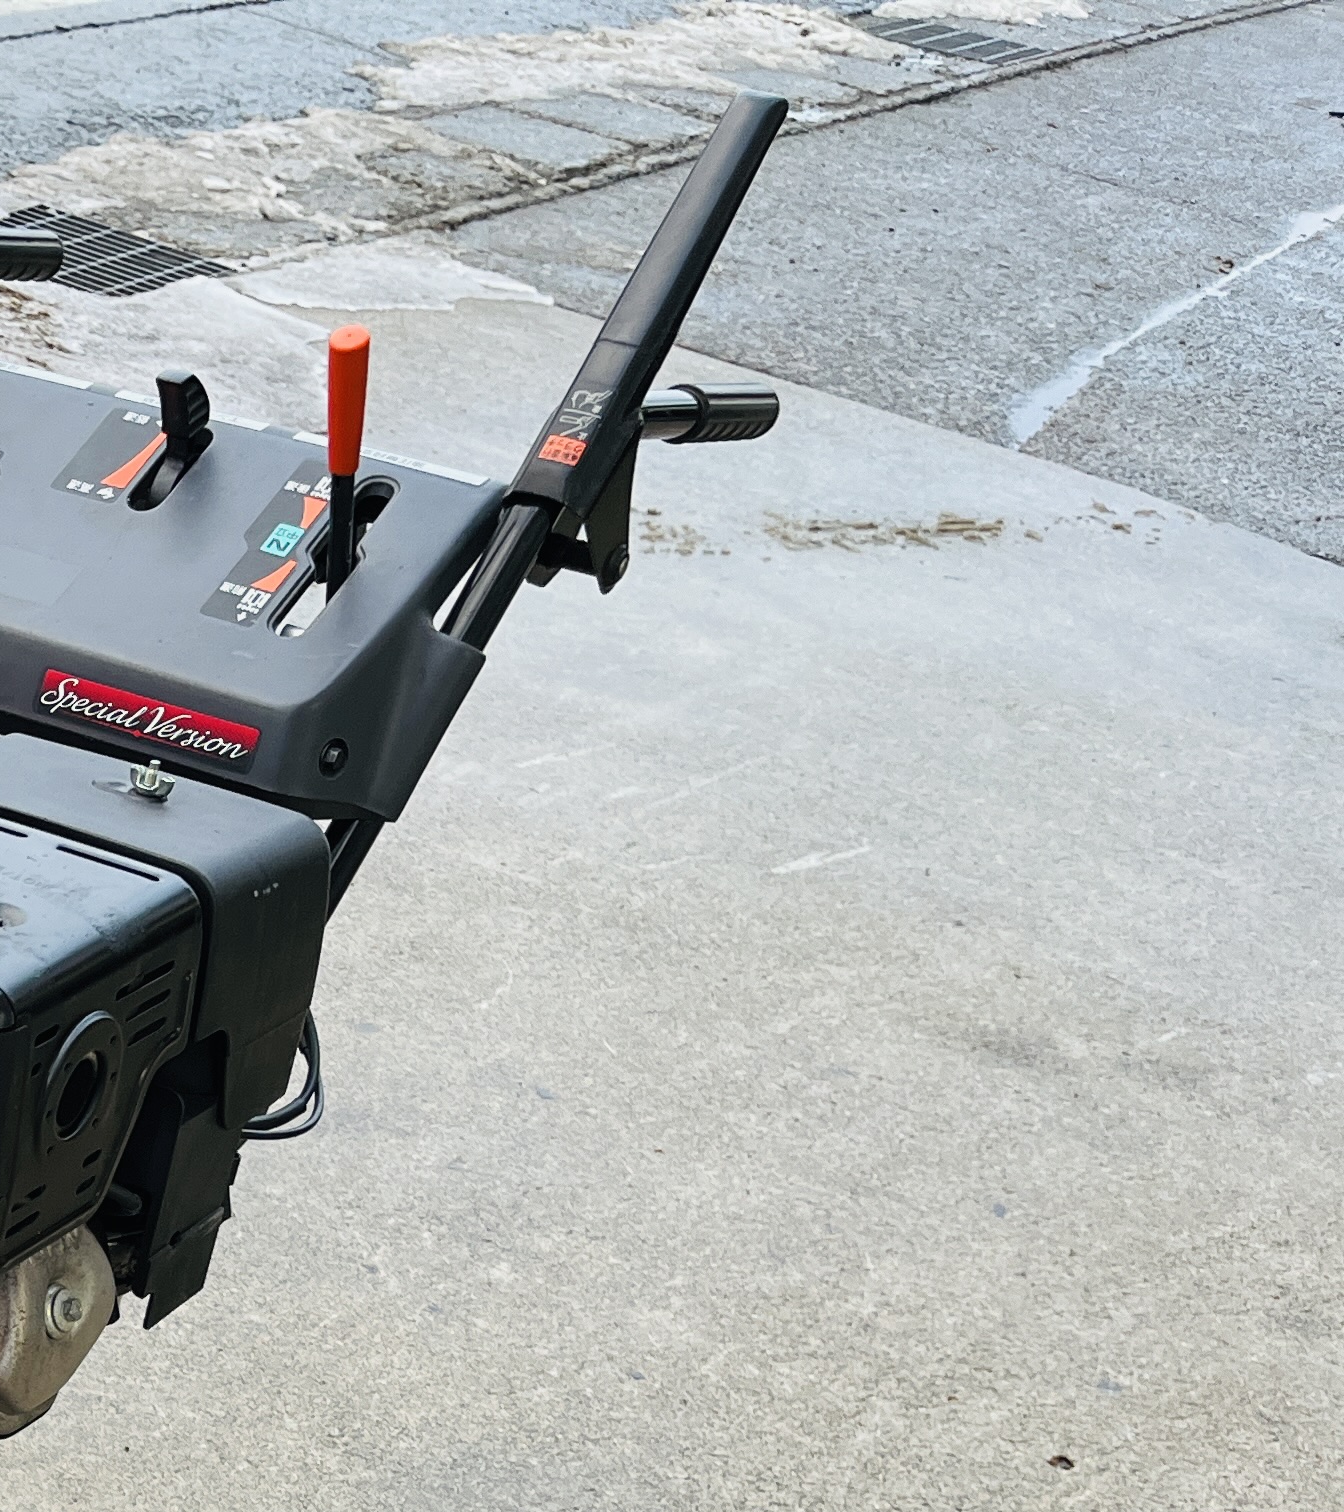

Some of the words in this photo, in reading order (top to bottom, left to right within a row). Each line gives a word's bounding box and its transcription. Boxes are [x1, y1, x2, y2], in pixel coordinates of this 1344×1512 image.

[274, 527, 298, 540] 中立
[267, 537, 290, 552] N
[40, 676, 147, 731] Special
[144, 705, 250, 759] Version
